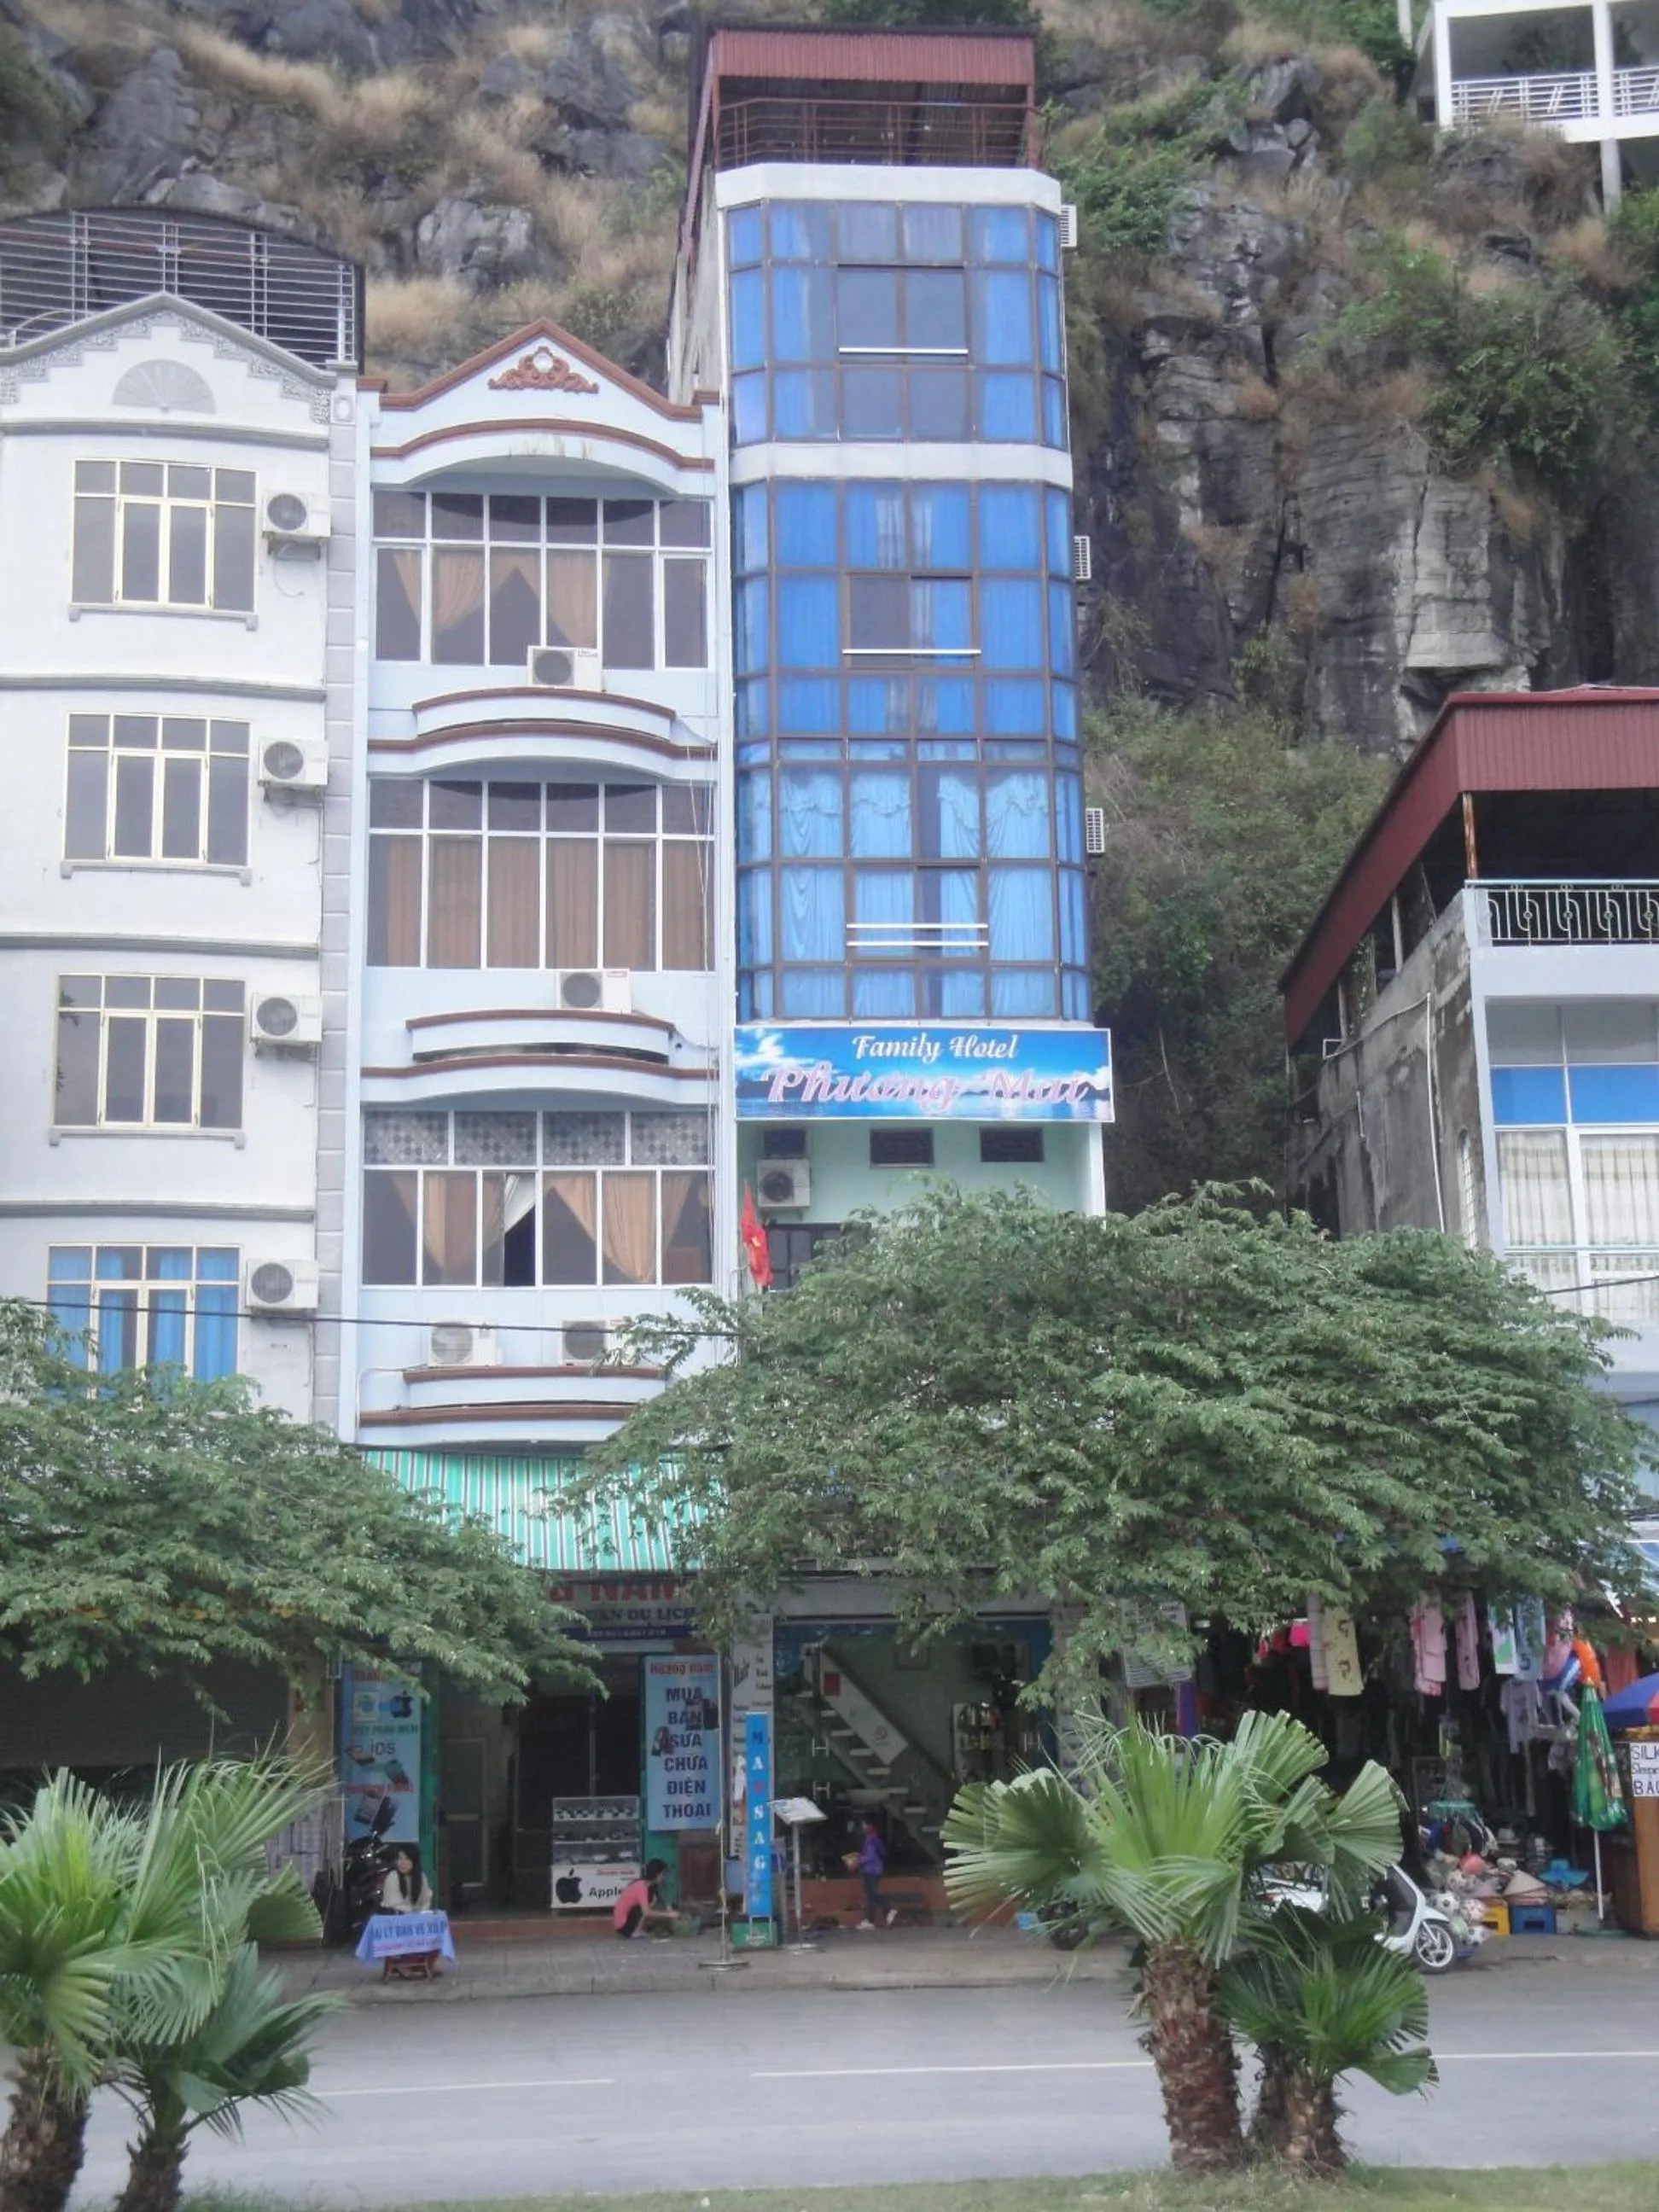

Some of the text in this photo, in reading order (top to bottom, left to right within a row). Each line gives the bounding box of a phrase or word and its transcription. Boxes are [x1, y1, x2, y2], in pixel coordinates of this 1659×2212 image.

[852, 1032, 1019, 1063] Family Hotel
[981, 1068, 1091, 1103] Mai
